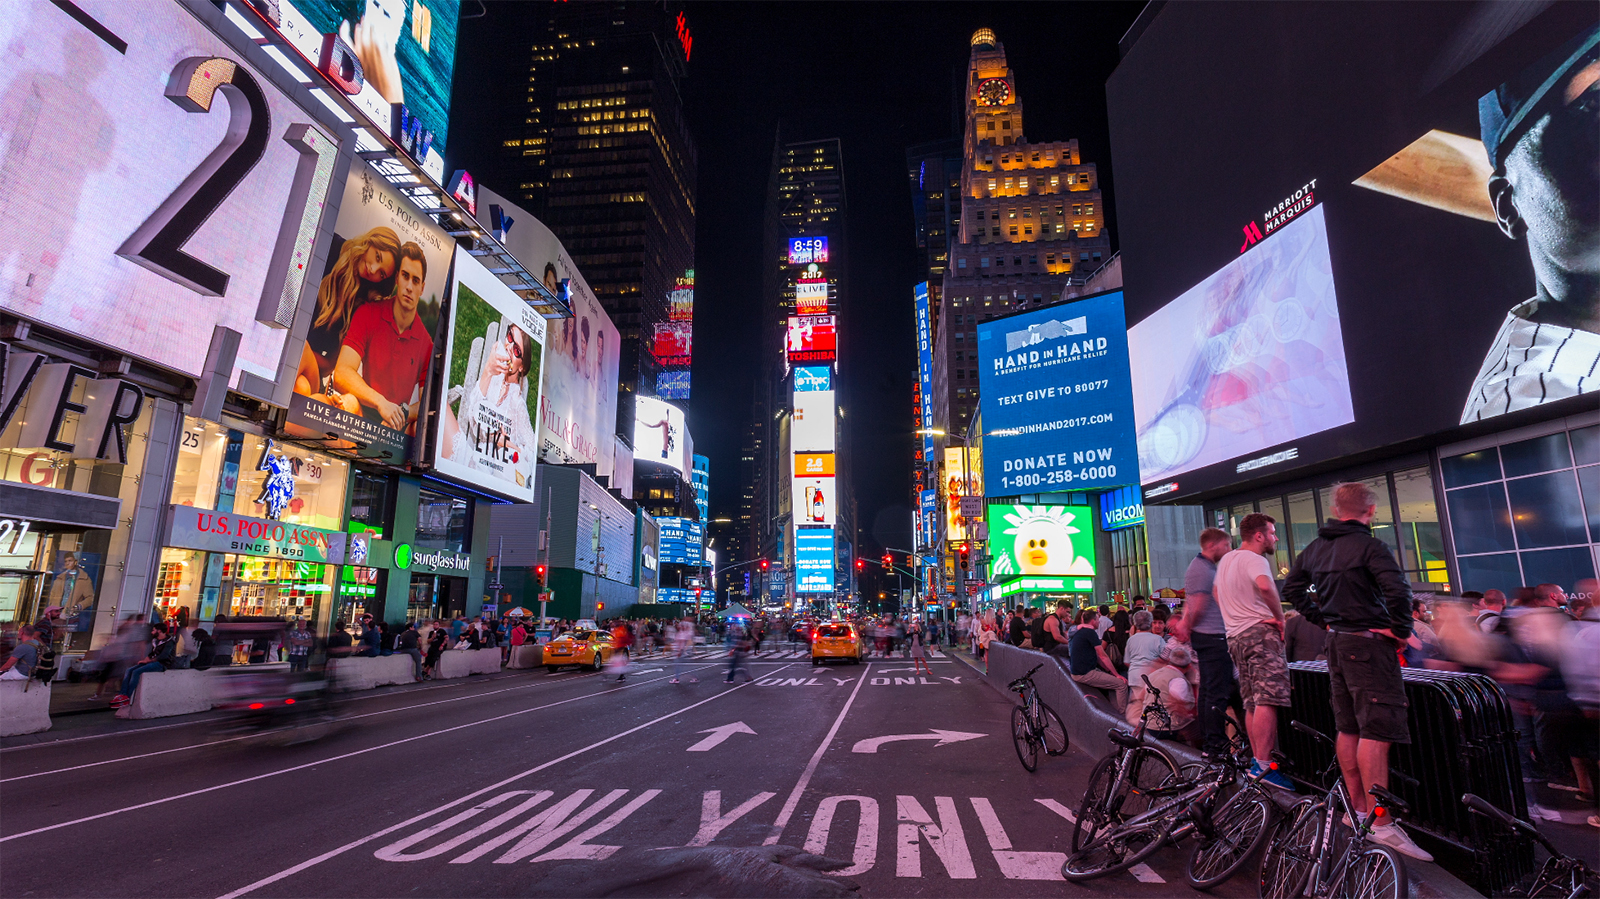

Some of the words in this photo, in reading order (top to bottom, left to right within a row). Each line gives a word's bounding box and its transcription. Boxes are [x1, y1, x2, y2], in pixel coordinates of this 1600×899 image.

[1264, 178, 1317, 221] MARRIOTT
[378, 192, 395, 213] U.S.
[396, 205, 420, 233] POLO
[419, 226, 443, 252] ASSN.
[1265, 194, 1313, 233] MARQUIS
[390, 217, 410, 236] SINCE
[794, 239, 823, 252] 8:59
[802, 271, 822, 279] 2017
[919, 308, 927, 351] HAND
[788, 351, 835, 361] TOSHIBA
[994, 351, 1039, 370] HAND
[1043, 350, 1053, 359] IN
[1057, 337, 1107, 358] HAND
[1001, 365, 1027, 375] BENEFIT
[1029, 362, 1042, 370] FOR
[1043, 355, 1081, 367] HURRICANE
[1083, 350, 1108, 359] RELIEF
[803, 376, 828, 385] TDK
[998, 394, 1024, 406] TEXT
[1026, 387, 1055, 401] GIVE
[1057, 386, 1071, 396] TO
[1075, 379, 1109, 393] 80077
[306, 401, 331, 417] LIVE
[335, 412, 405, 443] AUTHENTICALLY
[475, 421, 511, 464] LIKE
[306, 462, 322, 479] $30
[806, 458, 823, 467] 2.6
[1003, 453, 1067, 472] DONATE
[1073, 447, 1113, 465] NOW
[1001, 465, 1117, 489] 1-800-258-6000
[196, 512, 233, 536] U.S.
[237, 519, 285, 542] POLO
[290, 527, 333, 551] ASSN.
[231, 541, 270, 554] SINCE
[274, 545, 304, 558] 1890
[413, 551, 454, 571] sunglass
[455, 555, 470, 571] hut
[755, 677, 855, 687] ONLY
[869, 676, 962, 685] ONLY
[373, 788, 776, 864] ONLY
